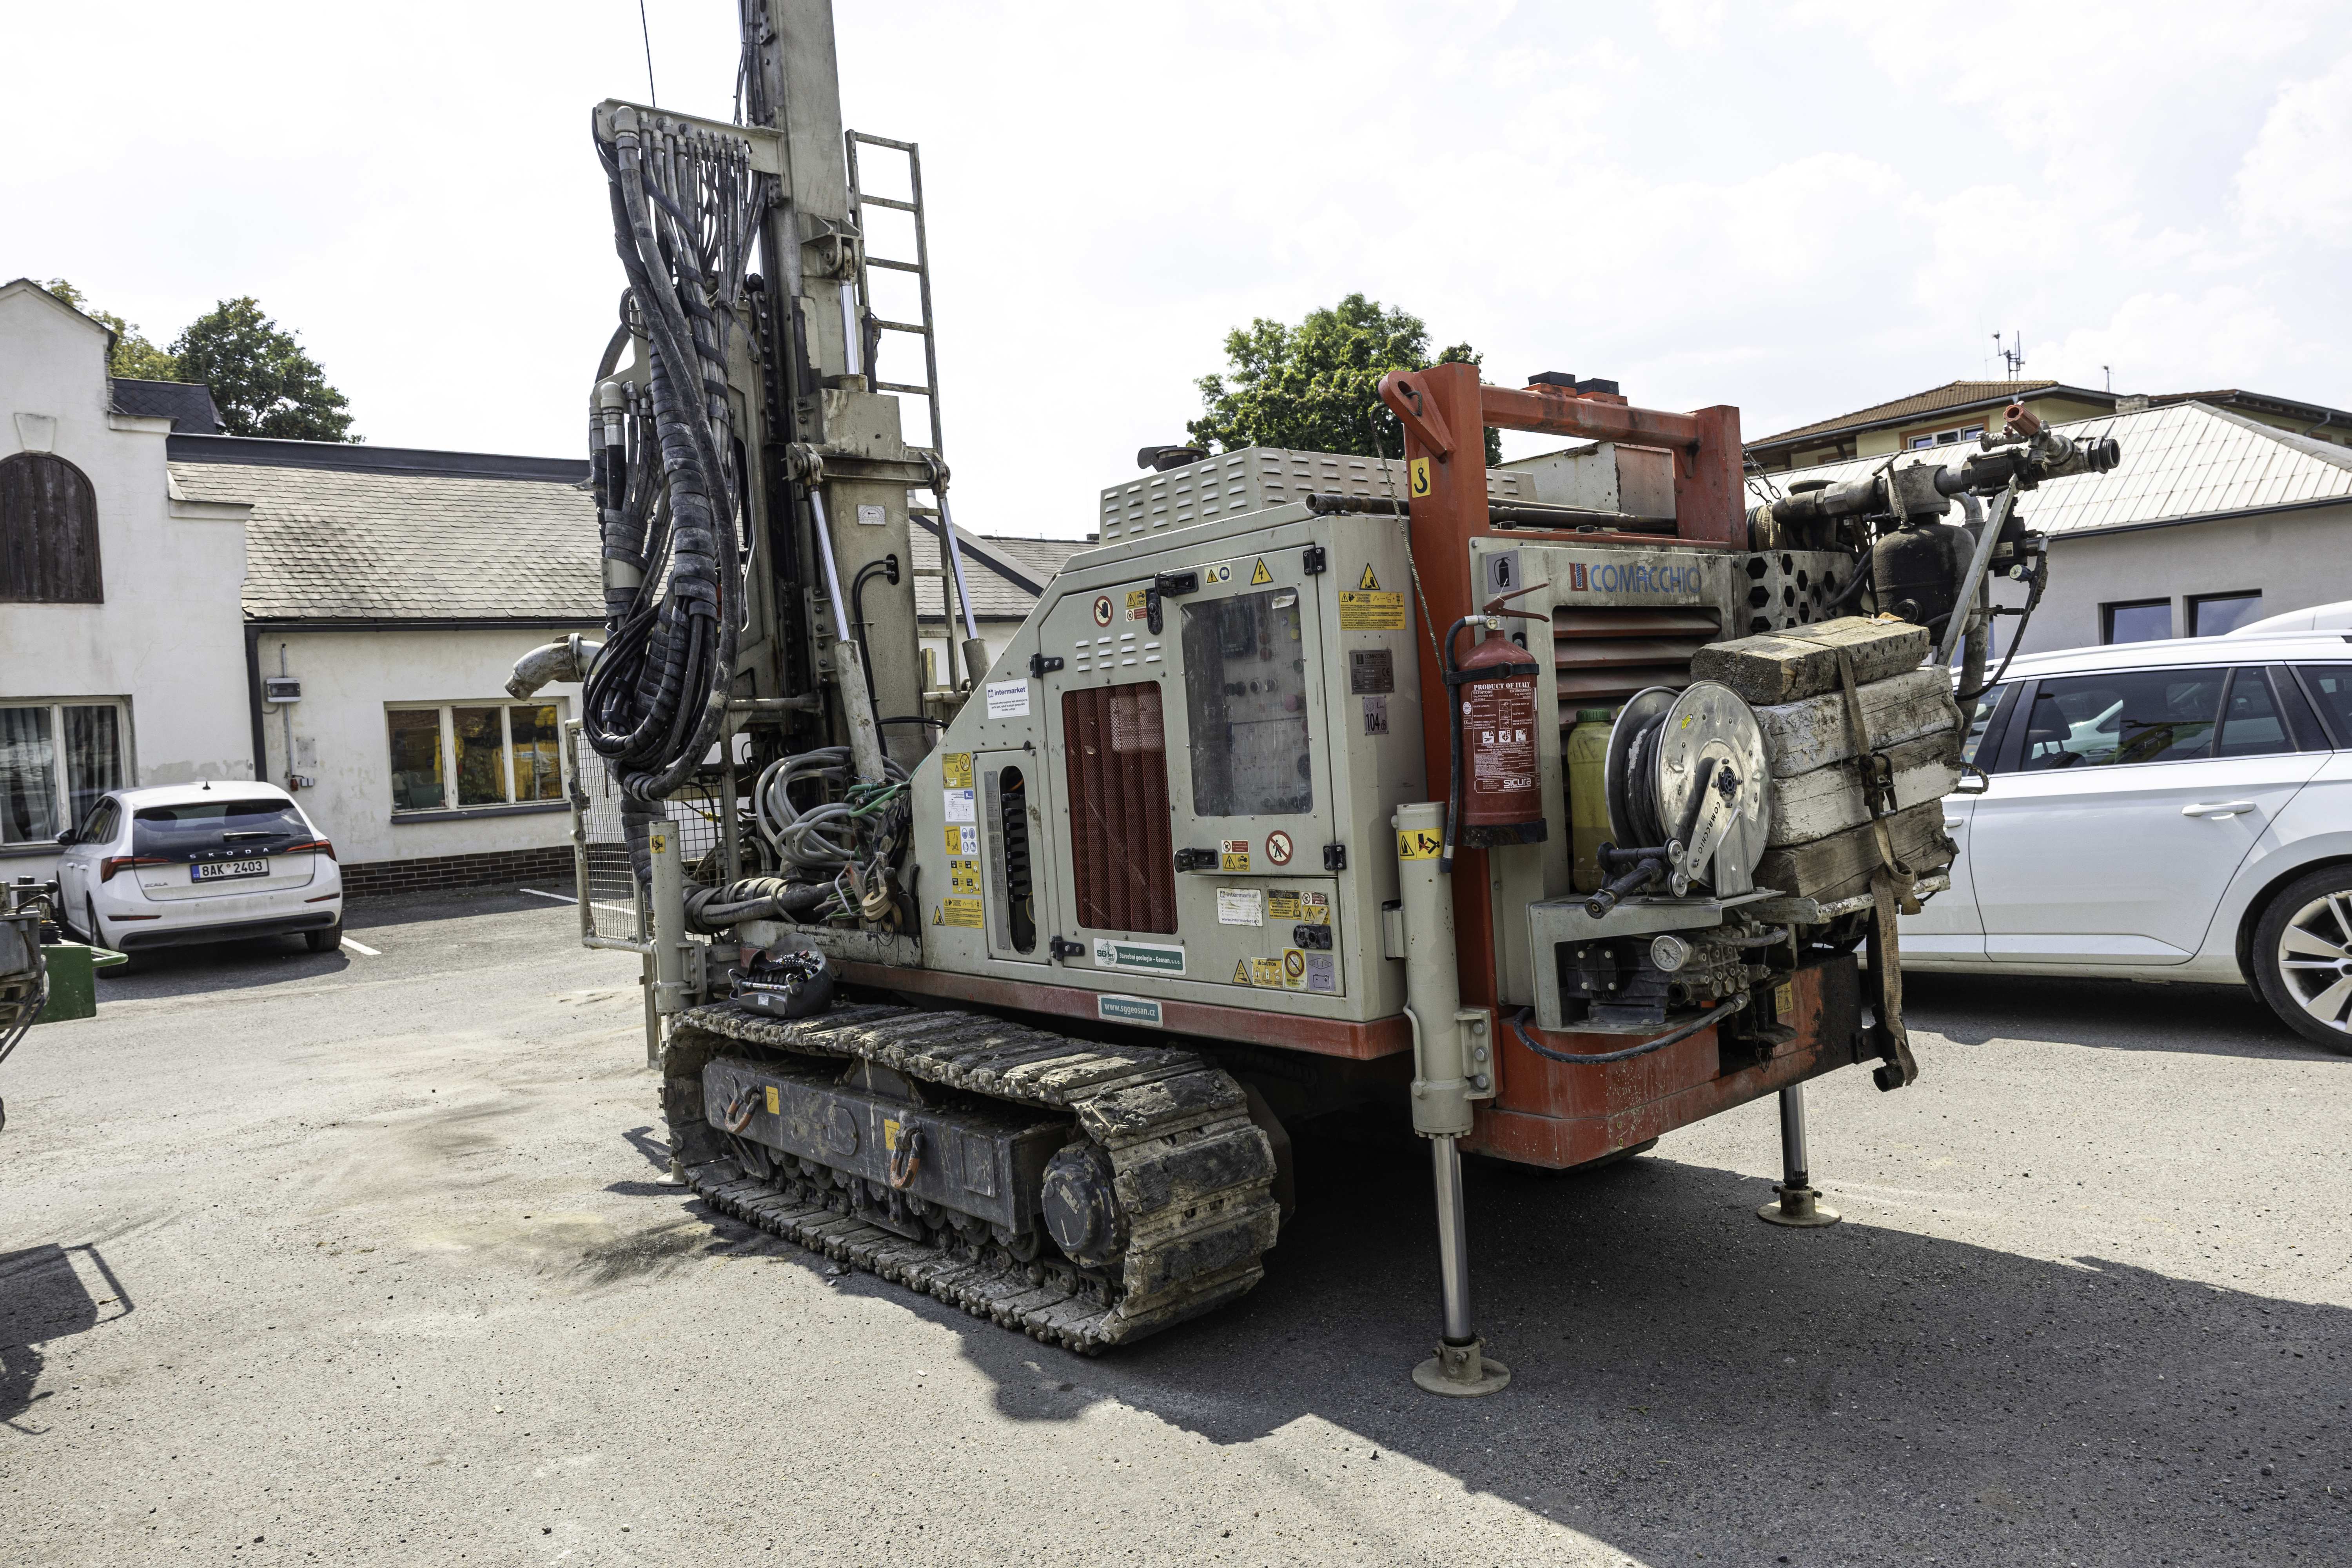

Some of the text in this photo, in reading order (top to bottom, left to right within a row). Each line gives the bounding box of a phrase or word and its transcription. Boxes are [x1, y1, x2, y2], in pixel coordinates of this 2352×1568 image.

[1590, 564, 1702, 593] COMACCHIO
[1382, 667, 1390, 677] CE
[995, 686, 1026, 696] intermarket
[1366, 713, 1380, 731] 104
[1381, 719, 1387, 730] dB
[202, 861, 262, 877] 8AK 2403
[1104, 1003, 1155, 1016] www.sggeosan.cz
